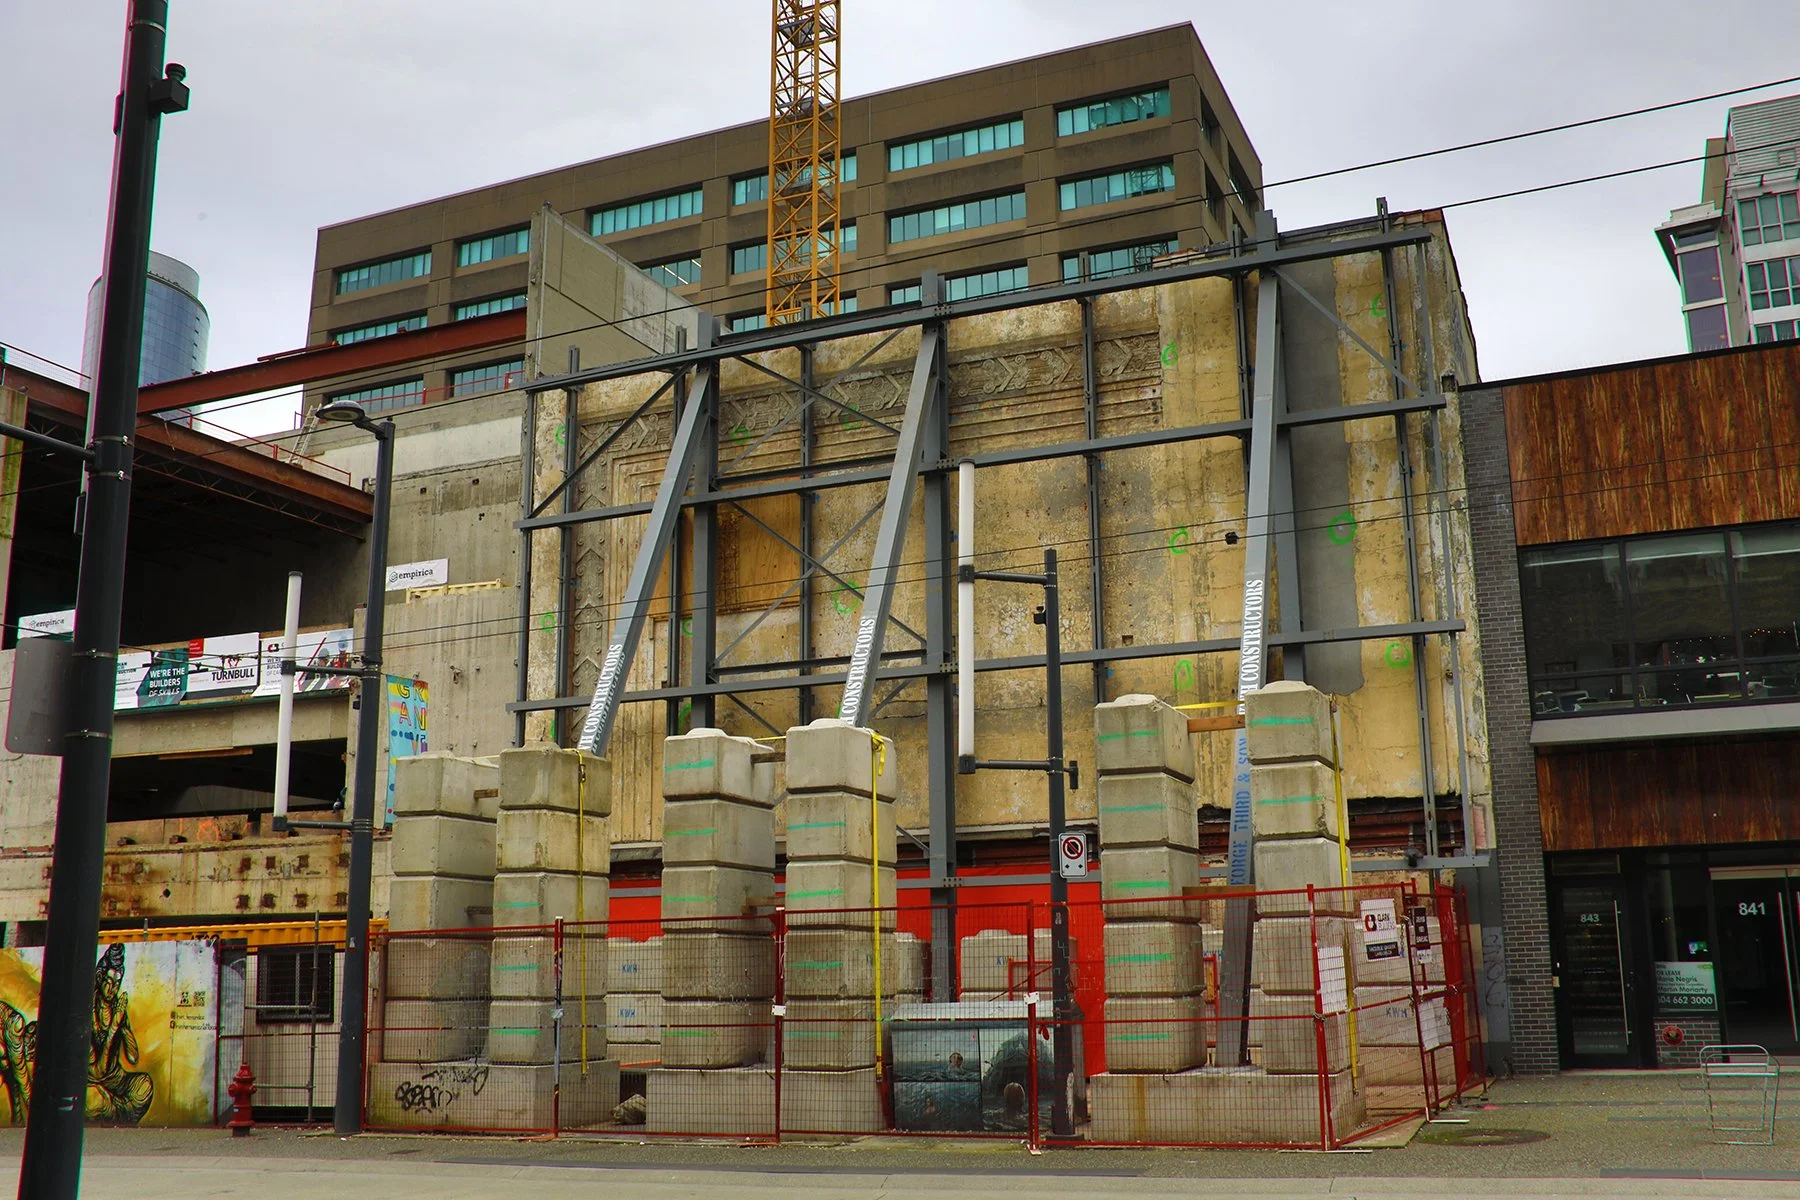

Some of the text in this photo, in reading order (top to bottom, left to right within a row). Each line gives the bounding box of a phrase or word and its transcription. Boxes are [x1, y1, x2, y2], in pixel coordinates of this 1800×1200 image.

[399, 569, 434, 580] empirica
[1240, 579, 1263, 681] CONSTRUCTORS
[150, 667, 185, 678] WE'RE THE
[841, 619, 875, 714] CONSTRUCTORS
[211, 668, 255, 682] TURNBULL
[149, 677, 181, 688] BUILDERS
[584, 644, 623, 733] CONSTRUCTORS
[1237, 773, 1250, 783] &
[1234, 791, 1251, 832] THIRD
[1230, 840, 1248, 885] EORGE
[1738, 902, 1766, 916] 841
[1580, 913, 1600, 923] 843
[1673, 996, 1689, 1004] 662
[1690, 996, 1713, 1004] 3000
[1386, 1007, 1408, 1018] KWH
